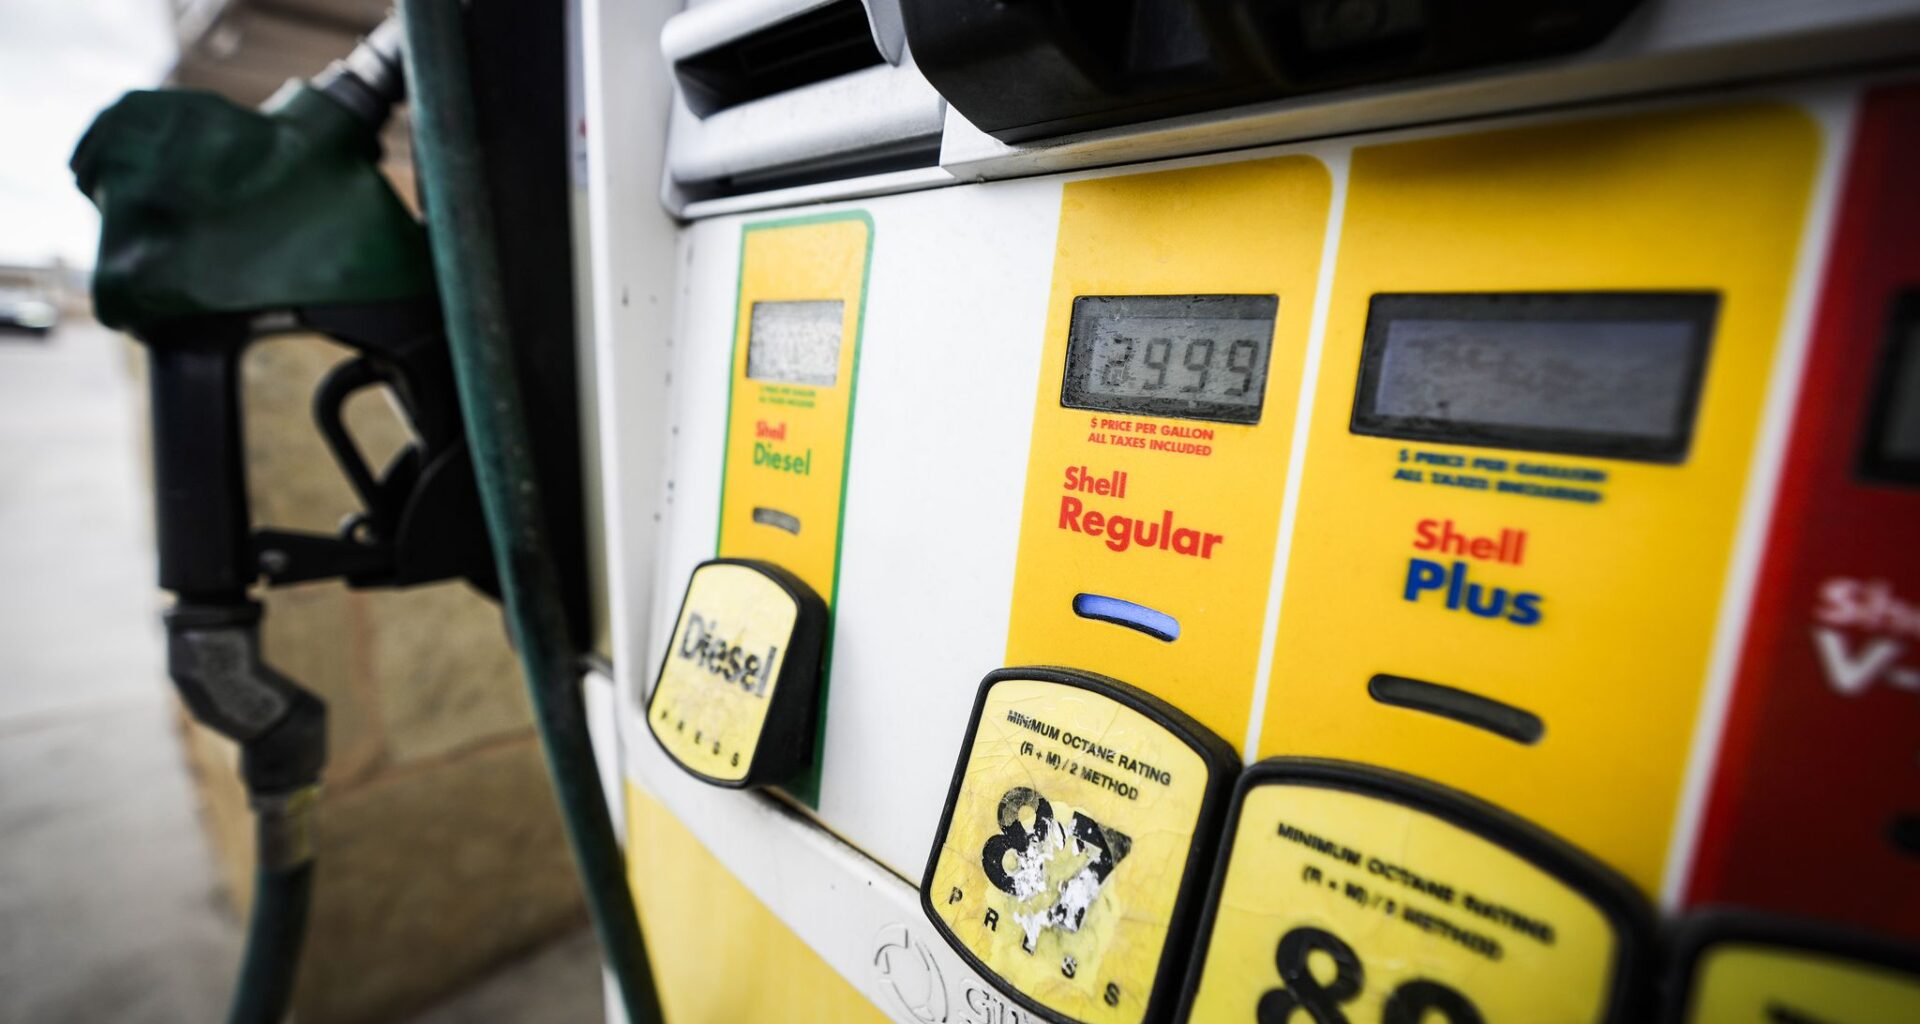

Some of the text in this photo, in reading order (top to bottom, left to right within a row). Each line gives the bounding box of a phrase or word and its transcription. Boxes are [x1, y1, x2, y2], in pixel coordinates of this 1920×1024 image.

[1088, 432, 1212, 456] ALL TAXES INCLUDED
[1090, 417, 1214, 440] $ PRICE PER GALLON
[753, 441, 812, 476] Diesel
[1063, 465, 1128, 499] Shell
[1058, 495, 1223, 560] Regular
[1412, 518, 1528, 566] Shell
[1402, 557, 1543, 627] Plus
[677, 611, 778, 699] Diesel
[1007, 710, 1172, 786] MINIMUM OCTANE RATING
[1070, 762, 1078, 775] 2
[1080, 766, 1139, 800] METHOD
